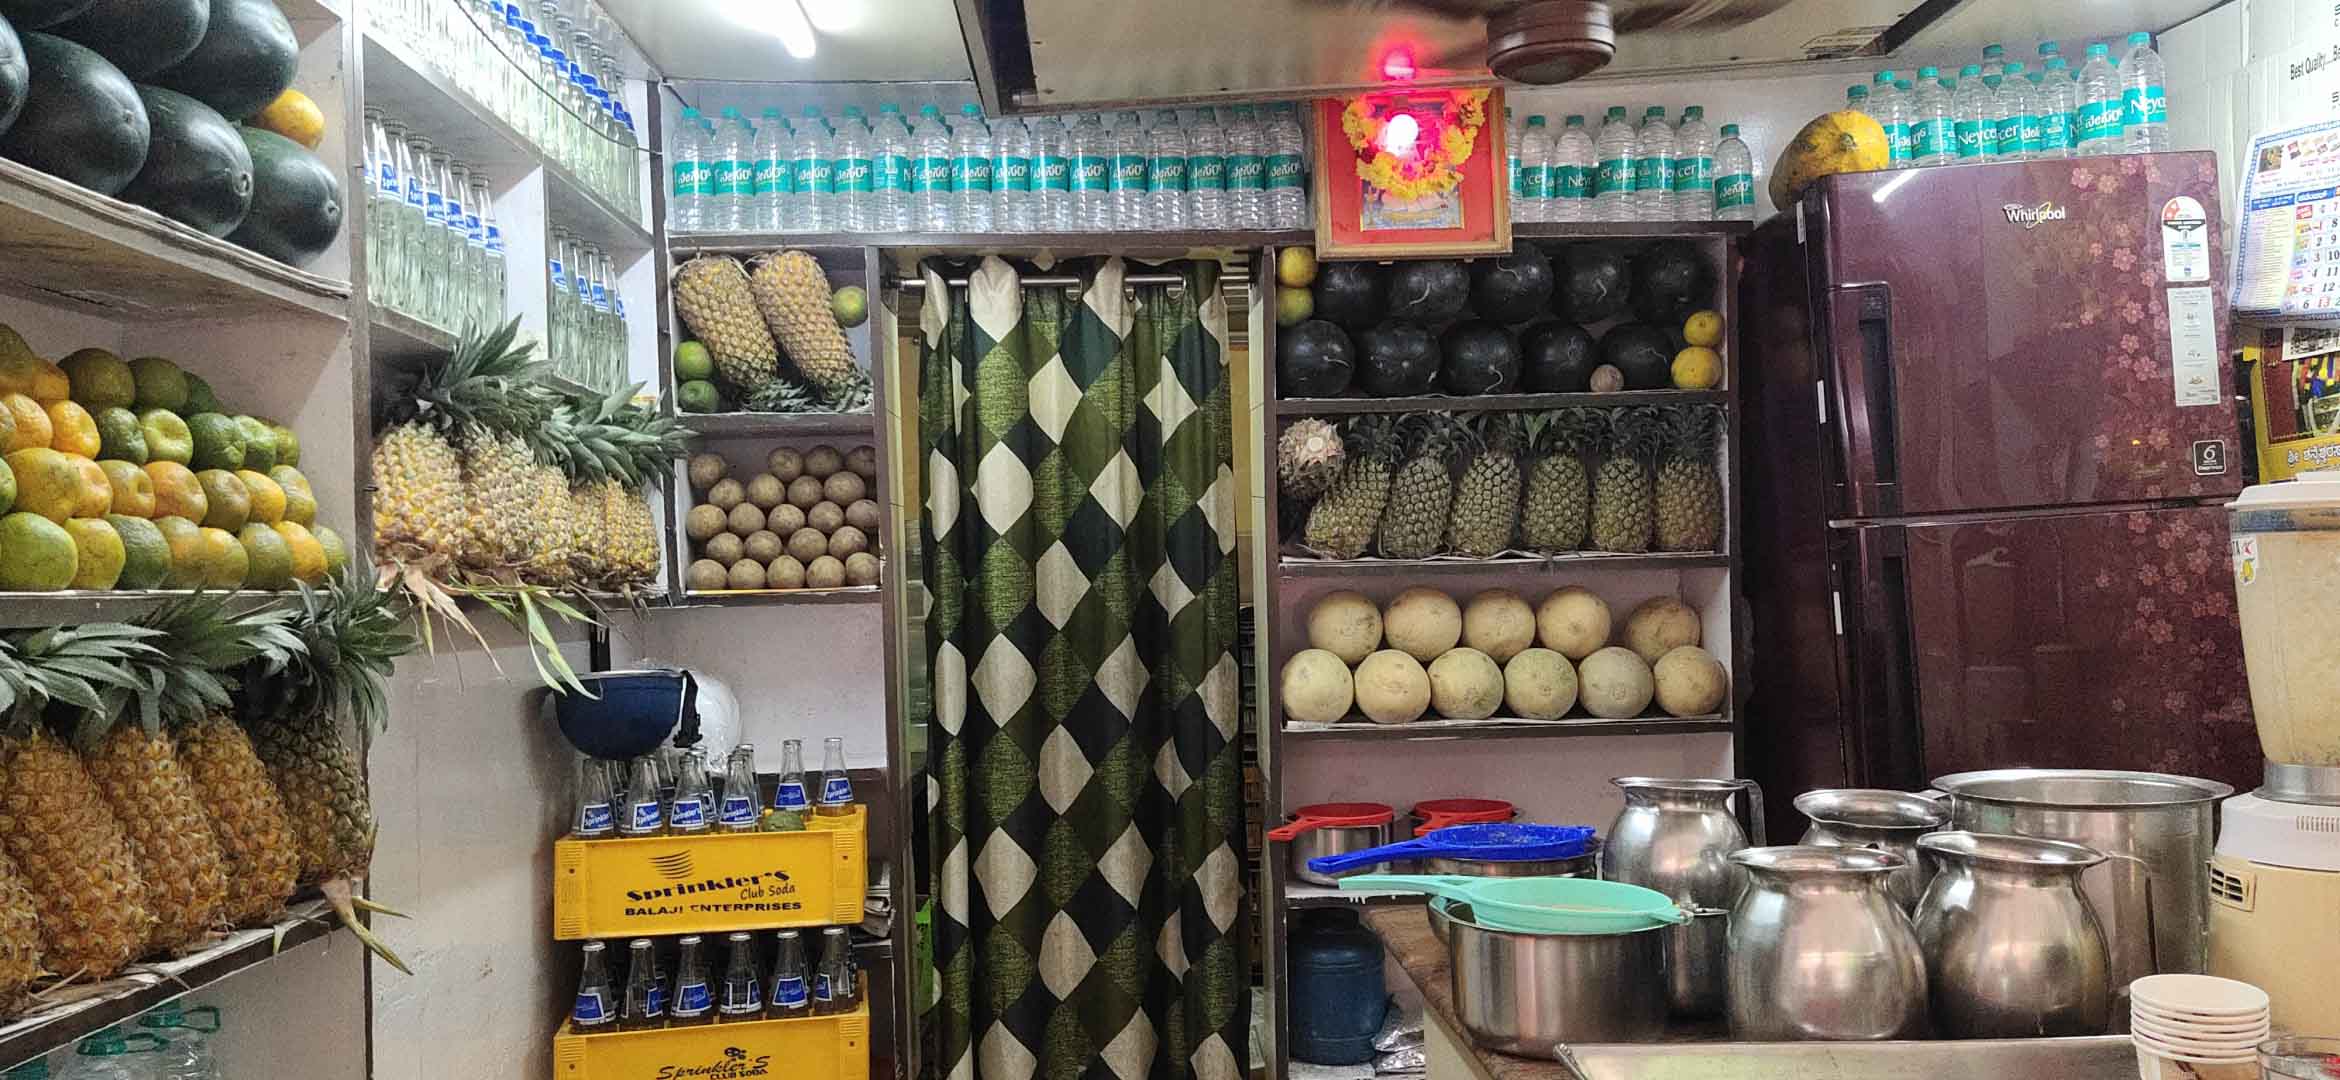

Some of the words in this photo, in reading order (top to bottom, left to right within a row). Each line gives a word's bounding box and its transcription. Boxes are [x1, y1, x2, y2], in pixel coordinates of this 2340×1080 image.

[2290, 61, 2304, 80] Best
[2006, 204, 2065, 223] Whirlpool
[2328, 250, 2340, 260] 10
[2327, 266, 2338, 276] 11
[2322, 281, 2335, 292] 12
[2204, 444, 2216, 460] 6
[740, 885, 764, 900] Club
[768, 882, 796, 897] Soda
[624, 904, 683, 916] BALAJI
[690, 902, 802, 913] ENTERPRISES
[710, 1072, 737, 1080] CLUB
[738, 1068, 769, 1078] SODA
